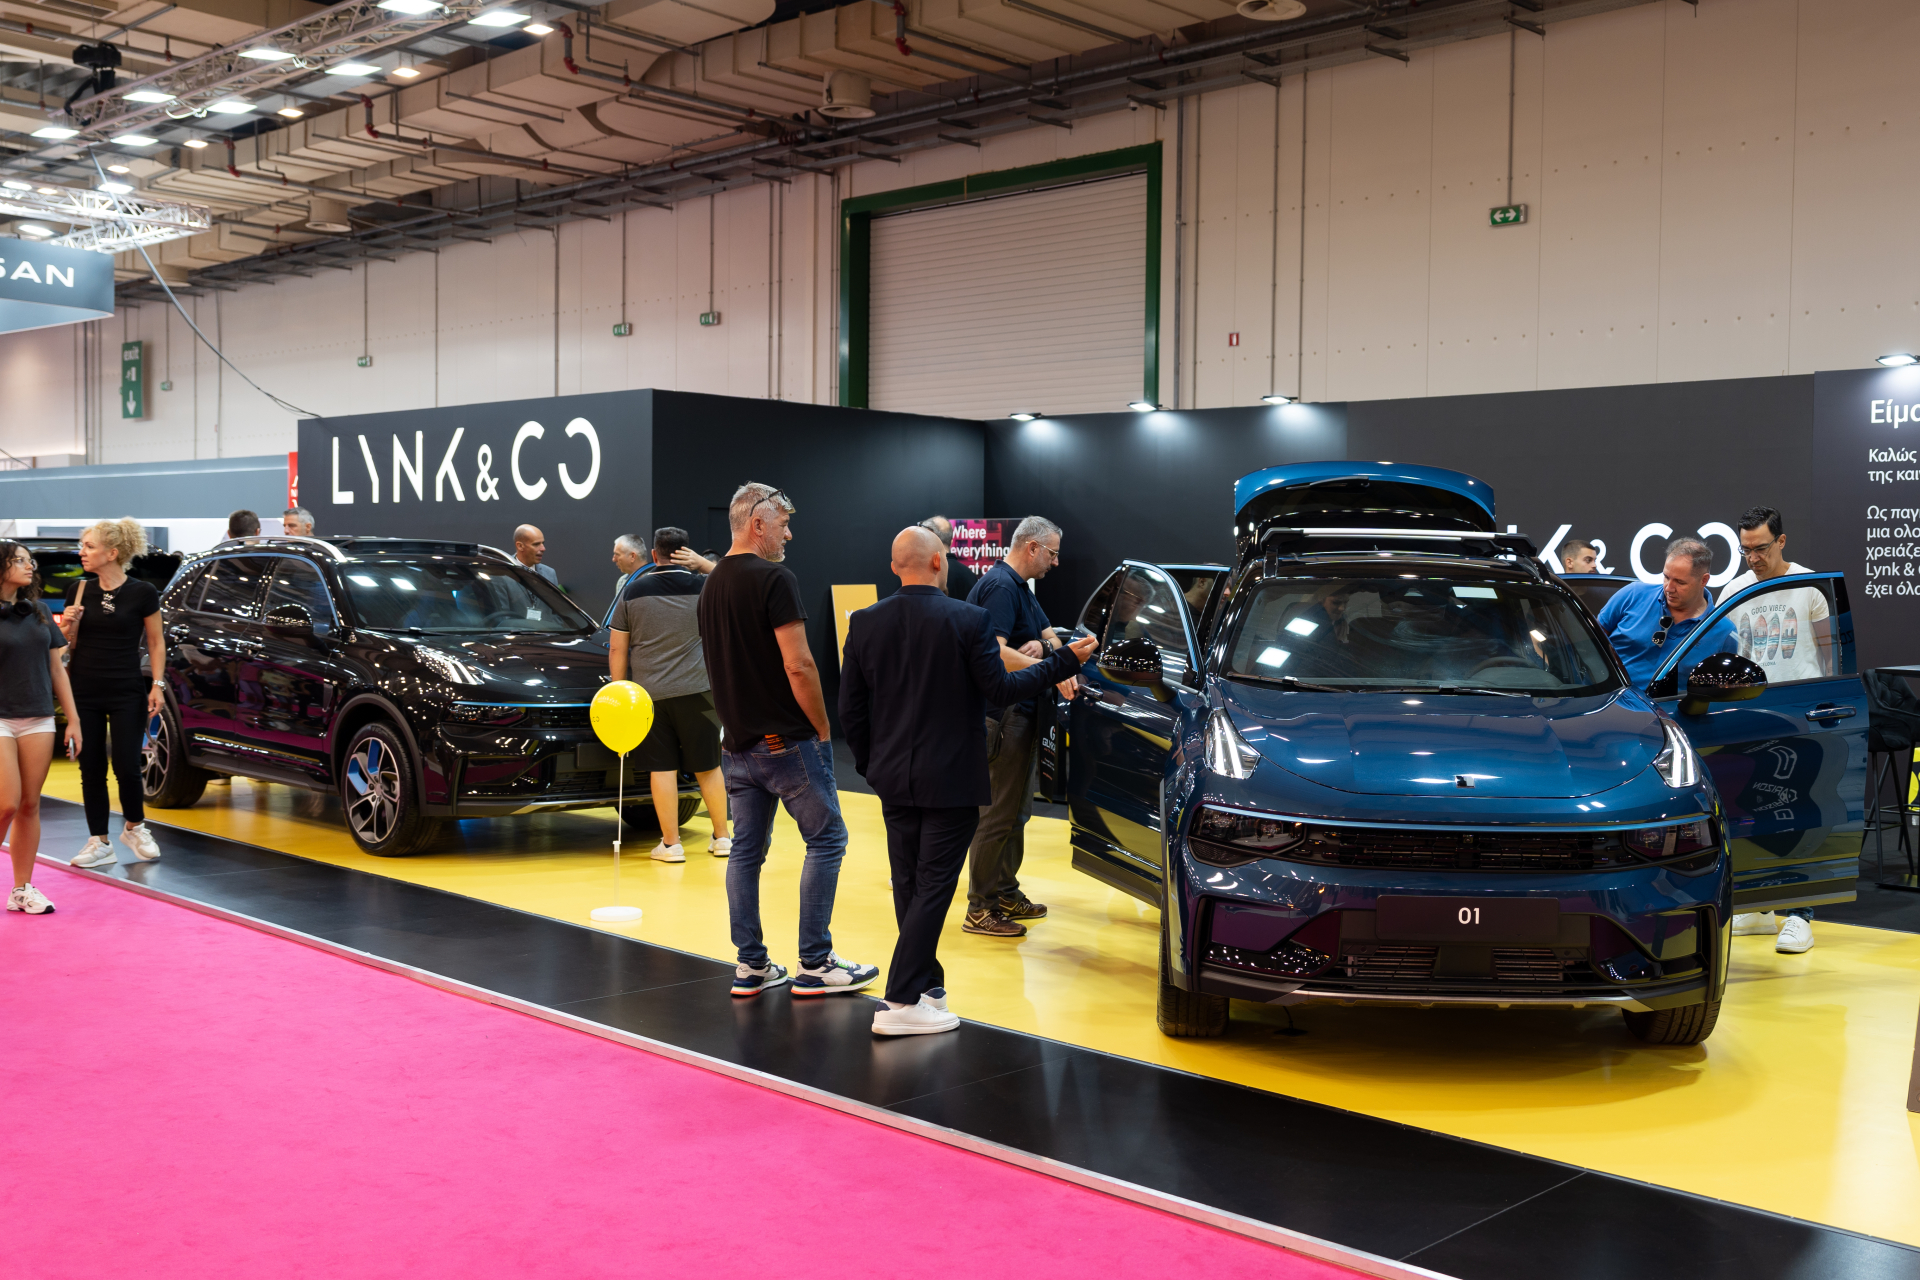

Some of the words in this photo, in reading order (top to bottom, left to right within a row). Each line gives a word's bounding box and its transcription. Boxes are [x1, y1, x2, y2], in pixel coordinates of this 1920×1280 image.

[0, 258, 75, 288] AN
[1869, 447, 1917, 464] Καλώς
[1867, 470, 1893, 485] της
[1867, 505, 1888, 521] Ως
[1890, 508, 1920, 522] παγ
[953, 525, 986, 539] Where
[1867, 527, 1890, 541] μια
[950, 543, 1010, 561] everything
[1866, 562, 1900, 579] Lynk
[1903, 562, 1915, 576] &
[1865, 581, 1893, 598] έχει
[1751, 605, 1767, 615] GOOD
[1769, 604, 1786, 612] VIBES
[1458, 907, 1480, 924] 01
